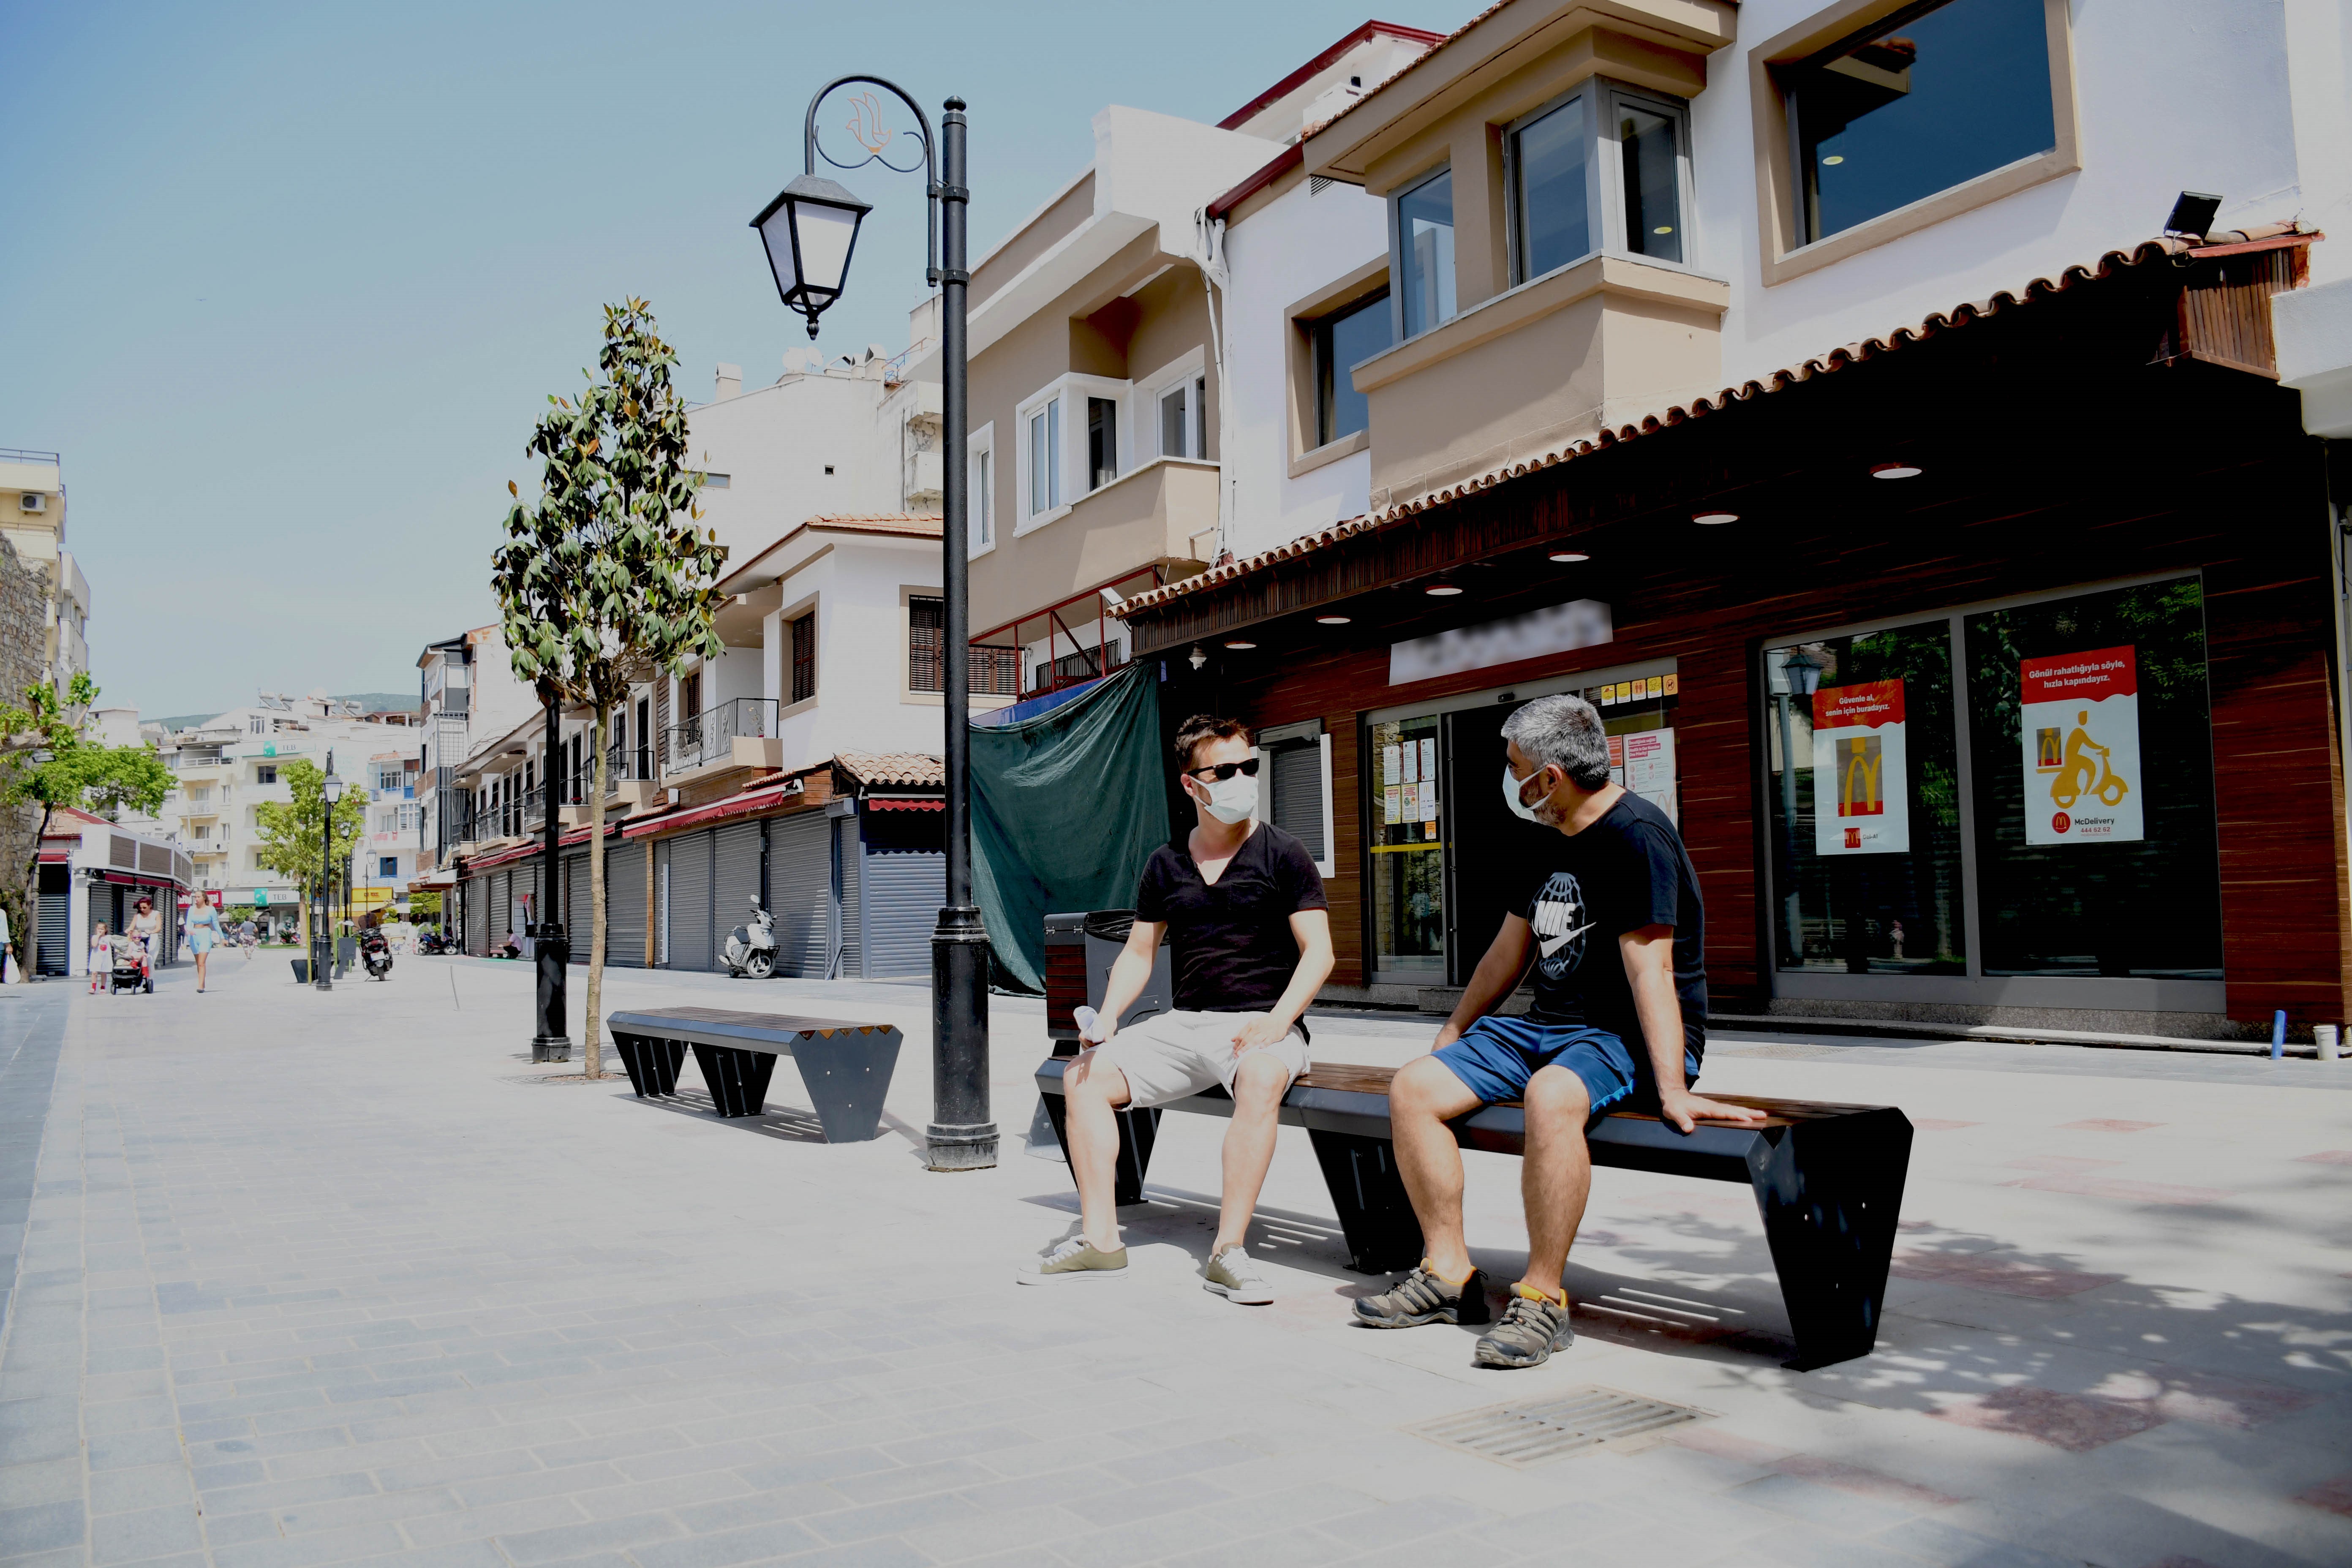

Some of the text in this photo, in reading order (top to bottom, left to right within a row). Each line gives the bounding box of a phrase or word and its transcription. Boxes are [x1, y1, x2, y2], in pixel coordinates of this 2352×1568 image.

[2029, 660, 2125, 678] Gönül rahatlığıyla söyle,
[2044, 675, 2110, 688] hızla kapındayız.
[1839, 694, 1874, 705] Güvenle al,
[1825, 704, 1890, 716] senin için buradayız.
[1534, 900, 1576, 937] NIKE
